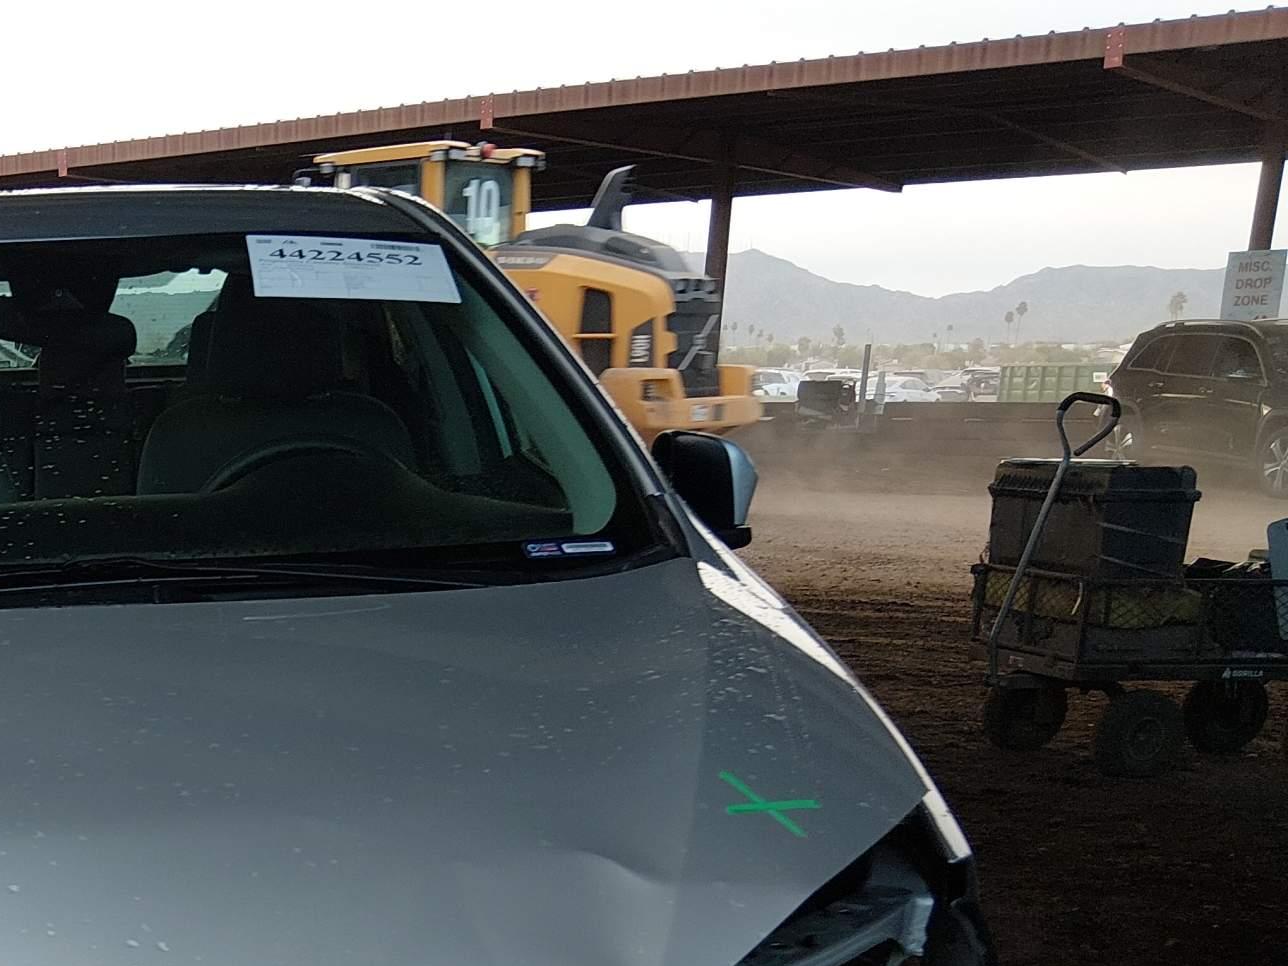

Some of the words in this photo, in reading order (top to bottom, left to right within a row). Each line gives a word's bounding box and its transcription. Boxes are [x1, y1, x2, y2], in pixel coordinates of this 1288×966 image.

[462, 179, 501, 242] 10
[269, 248, 423, 266] 44224552
[1235, 277, 1272, 289] DROP
[1233, 294, 1268, 307] ZONE
